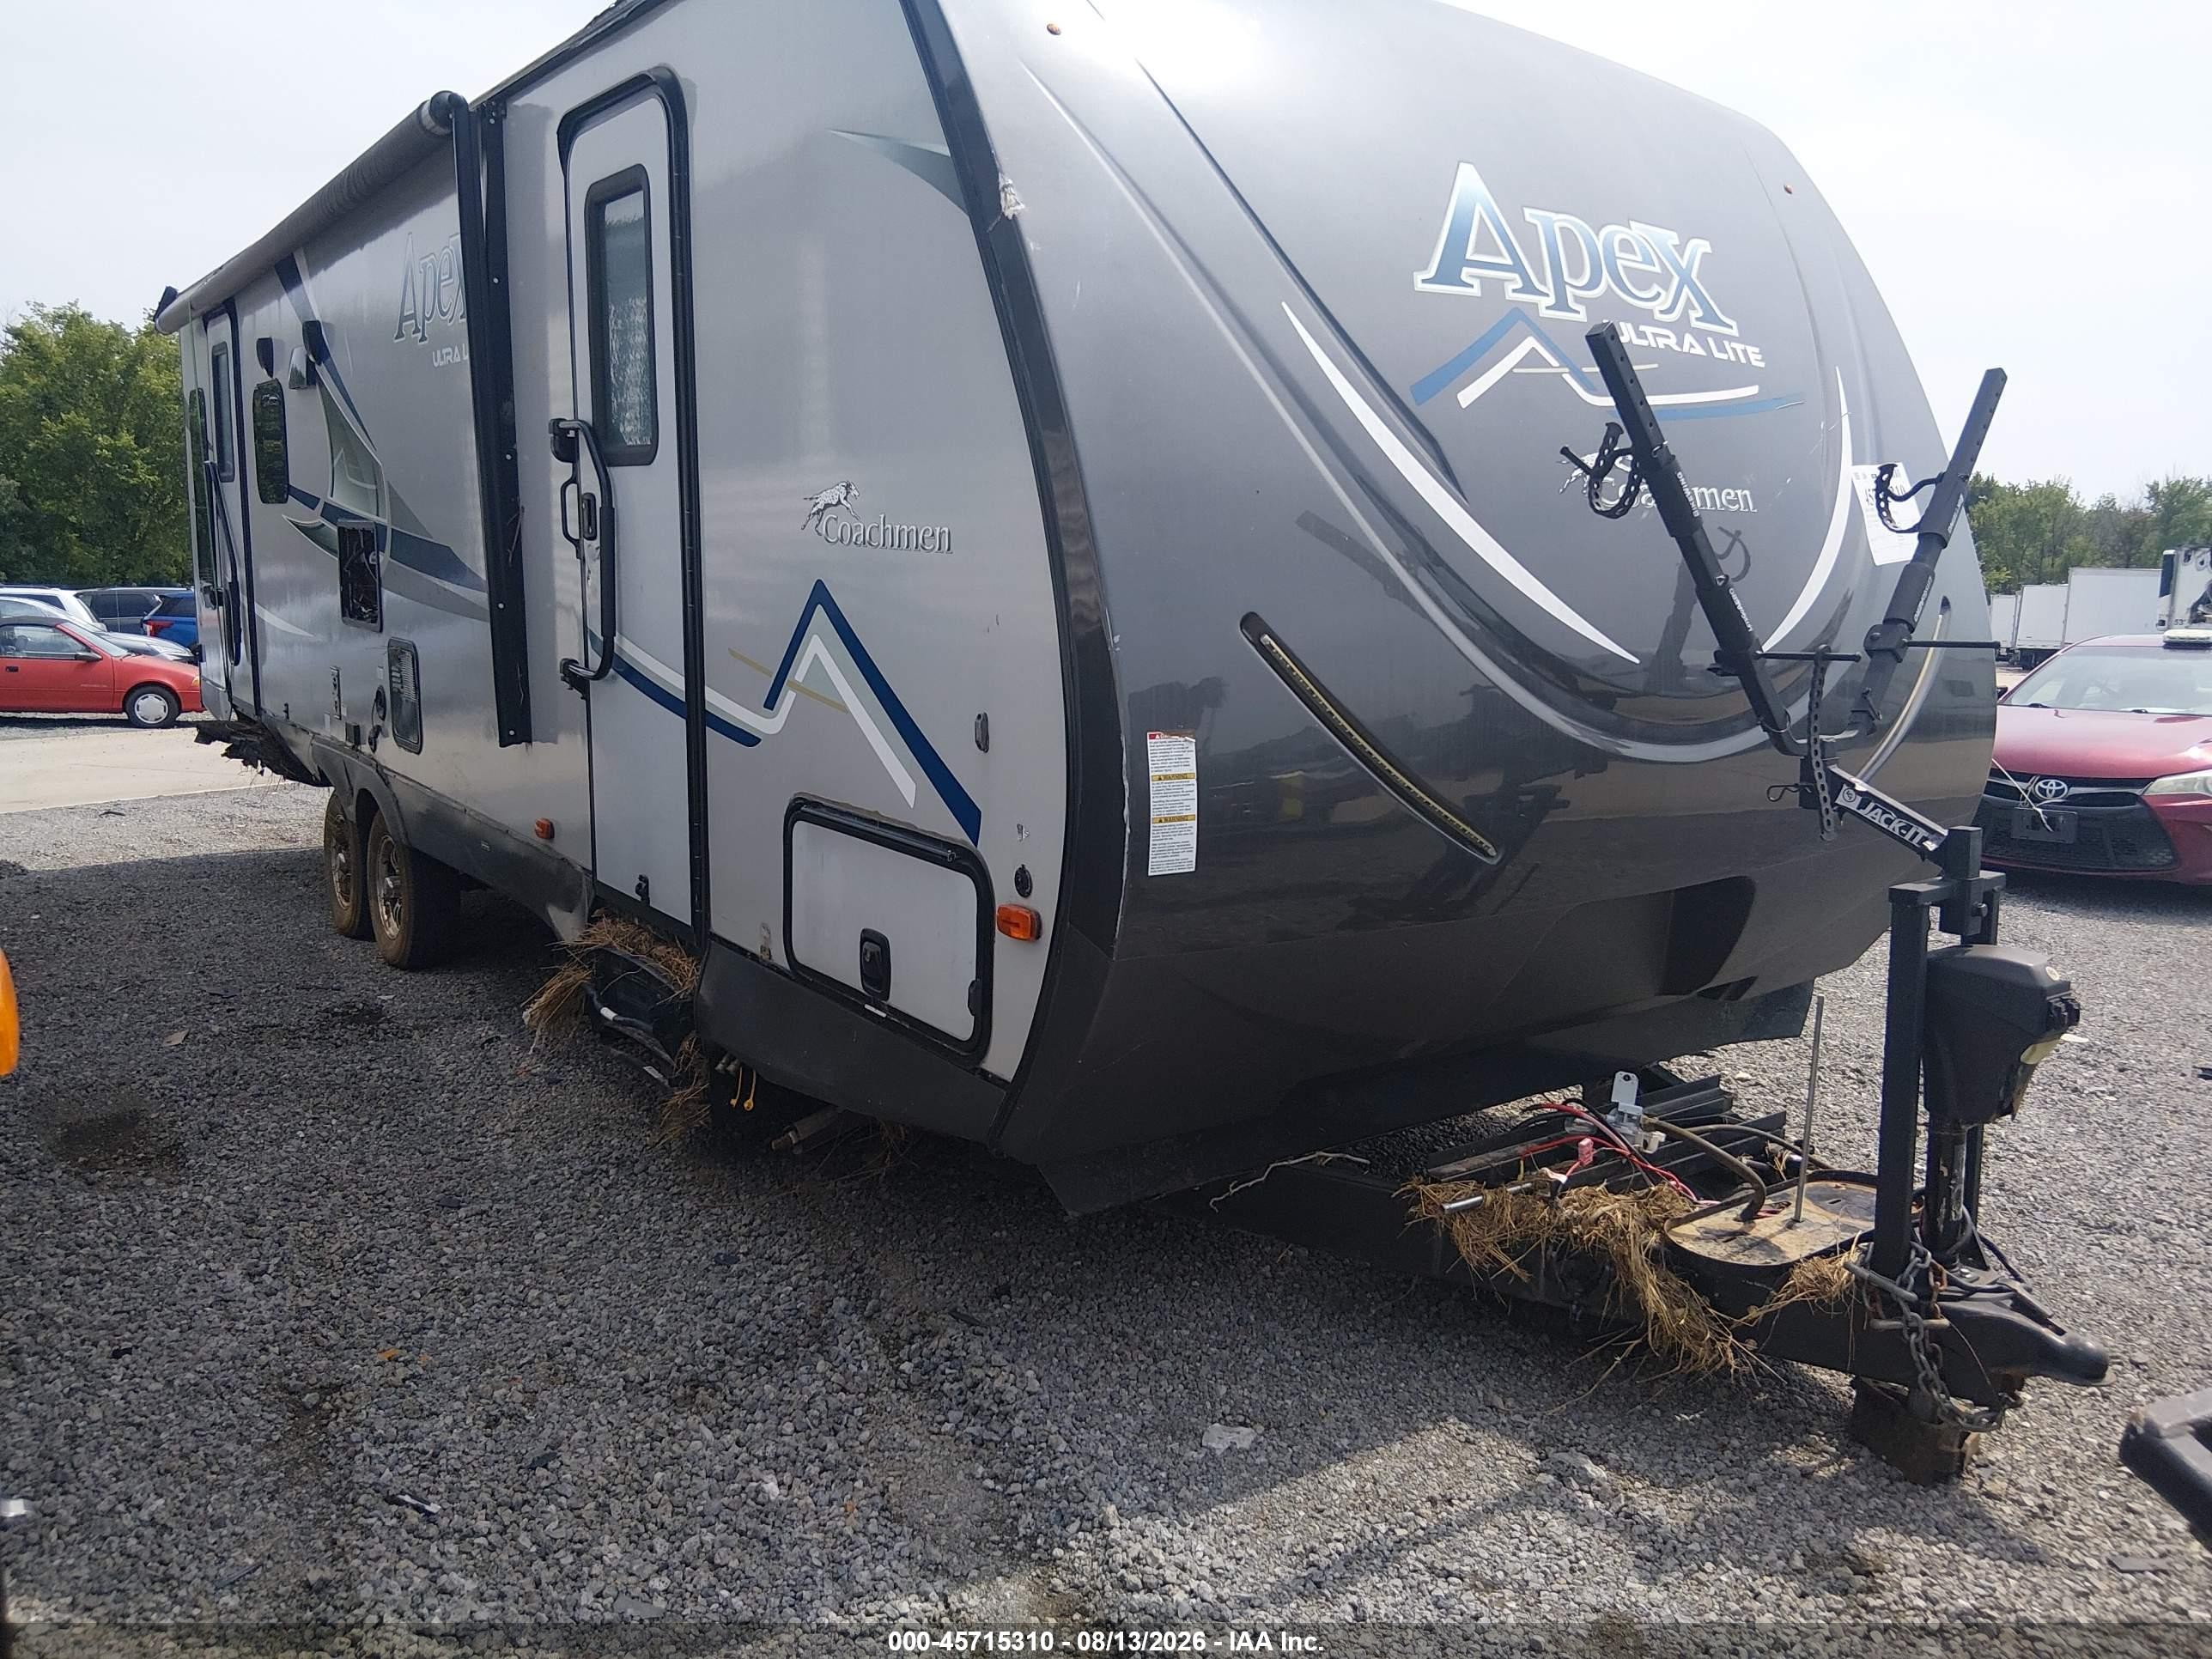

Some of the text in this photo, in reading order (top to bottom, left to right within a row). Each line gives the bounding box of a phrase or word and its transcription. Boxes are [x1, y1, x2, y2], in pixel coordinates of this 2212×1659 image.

[1413, 161, 1739, 337] Apex
[433, 346, 461, 368] ULTRA
[1707, 337, 1765, 368] LITE
[822, 514, 953, 554] Coachmen
[1859, 802, 1929, 847] JACK-IT
